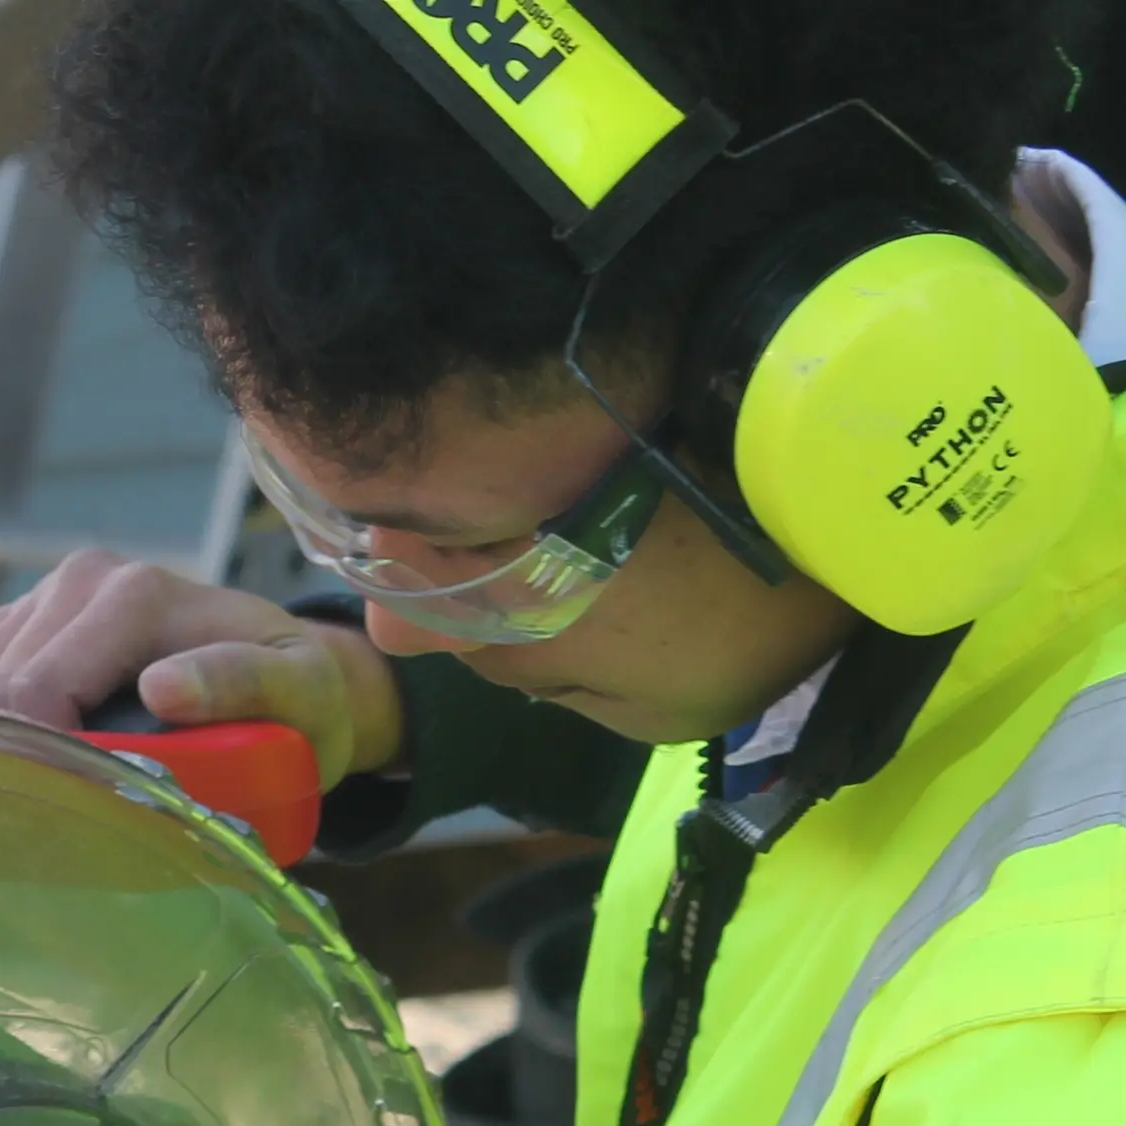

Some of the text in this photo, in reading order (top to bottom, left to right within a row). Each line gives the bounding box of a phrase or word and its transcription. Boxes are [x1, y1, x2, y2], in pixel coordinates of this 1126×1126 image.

[551, 27, 580, 55] PRO
[886, 385, 1006, 511] PYTHON
[906, 405, 946, 448] PRO
